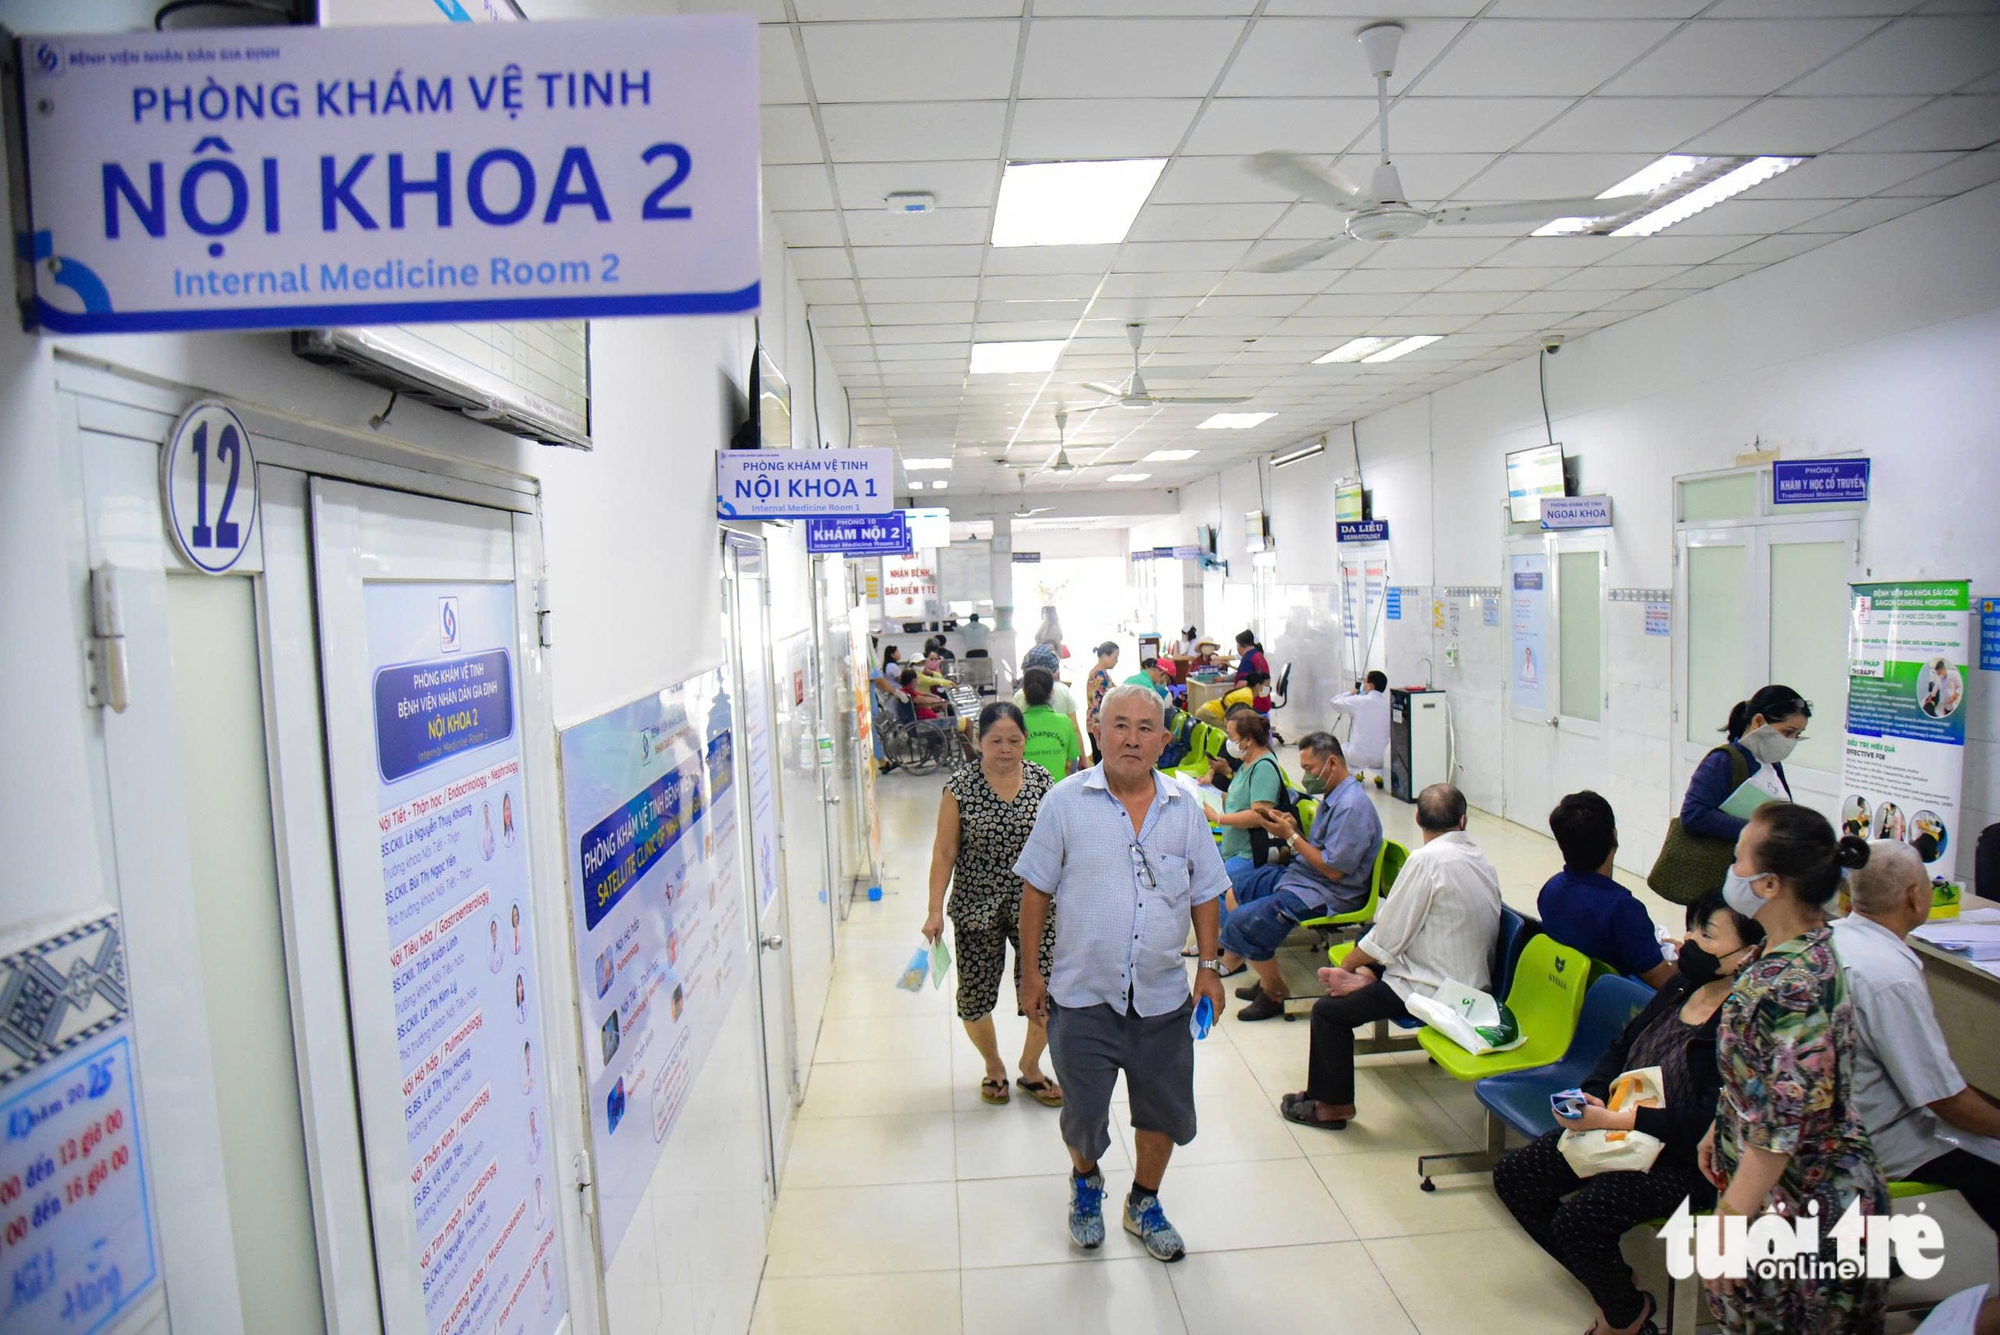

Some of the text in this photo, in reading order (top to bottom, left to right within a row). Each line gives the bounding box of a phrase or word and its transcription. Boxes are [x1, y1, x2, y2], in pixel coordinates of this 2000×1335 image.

[132, 63, 651, 125] PHÒNG KHÁM VỆ TINH
[102, 135, 693, 258] NỘI KHOA 2
[173, 253, 621, 298] Internal Medicine Room 2
[743, 458, 868, 473] PHÒNG KHÁM VỆ TINH
[191, 423, 240, 550] 12
[735, 474, 878, 503] NỘI KHOA 1
[1780, 477, 1801, 491] KHÁM
[1802, 479, 1809, 490] Y
[1809, 479, 1824, 491] HỌC
[1825, 474, 1836, 490] CỔ
[752, 503, 861, 513] Internal Medicine Room 1
[1580, 509, 1607, 518] KHOA
[813, 525, 901, 541] KHÁM NỘI 2
[1341, 525, 1356, 533] DA
[1343, 533, 1381, 541] DERMATOLOGY
[921, 586, 926, 594] Y
[413, 661, 484, 690] PHÒNG KHÁM VỆ TINH
[1852, 668, 1876, 676] THERAPY
[398, 680, 498, 719] BỆNH VIỆN NHÂN DÂN GIA ĐỊNH
[428, 708, 479, 740] NỘI KHOA 2
[1846, 747, 1874, 759] EFFECTIVE
[392, 806, 407, 826] Tiết
[431, 794, 442, 809] học
[448, 774, 487, 801] Endocrinology
[490, 760, 519, 781] Nephrology
[584, 835, 615, 878] PHÒNG
[616, 811, 638, 850] KHÁM
[638, 801, 649, 830] VỆ
[649, 795, 664, 822] TINH
[597, 853, 637, 908] SATELLITE
[636, 836, 657, 869] CLINIC
[657, 826, 667, 849] OF
[403, 939, 419, 960] Tiêu
[439, 889, 490, 934] Gastroenterology
[446, 935, 459, 953] Linh
[439, 987, 451, 1005] Kim
[444, 1011, 483, 1057] Pulmonology
[460, 1087, 490, 1127] Neurology
[105, 1108, 124, 1136] 00
[111, 1144, 130, 1172] 00
[431, 1232, 445, 1255] Tim
[467, 1160, 497, 1207] Cardiology
